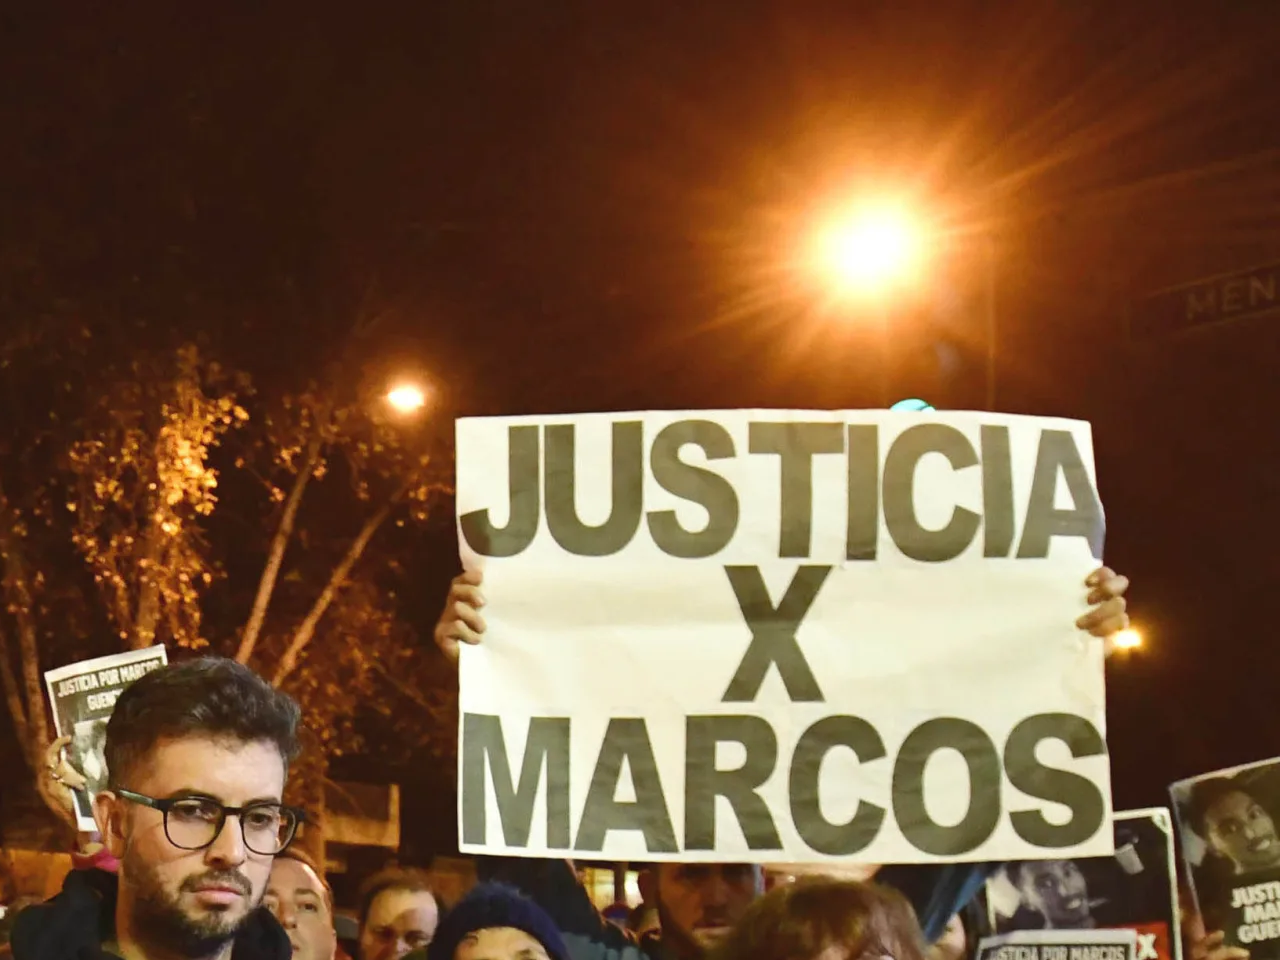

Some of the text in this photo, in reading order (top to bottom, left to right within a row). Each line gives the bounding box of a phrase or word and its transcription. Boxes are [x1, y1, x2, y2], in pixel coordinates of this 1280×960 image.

[459, 419, 1106, 563] JUSTICIA
[58, 673, 99, 698] JUSTICIA
[98, 669, 121, 687] POR
[721, 564, 833, 703] X
[462, 712, 1109, 857] MARCOS
